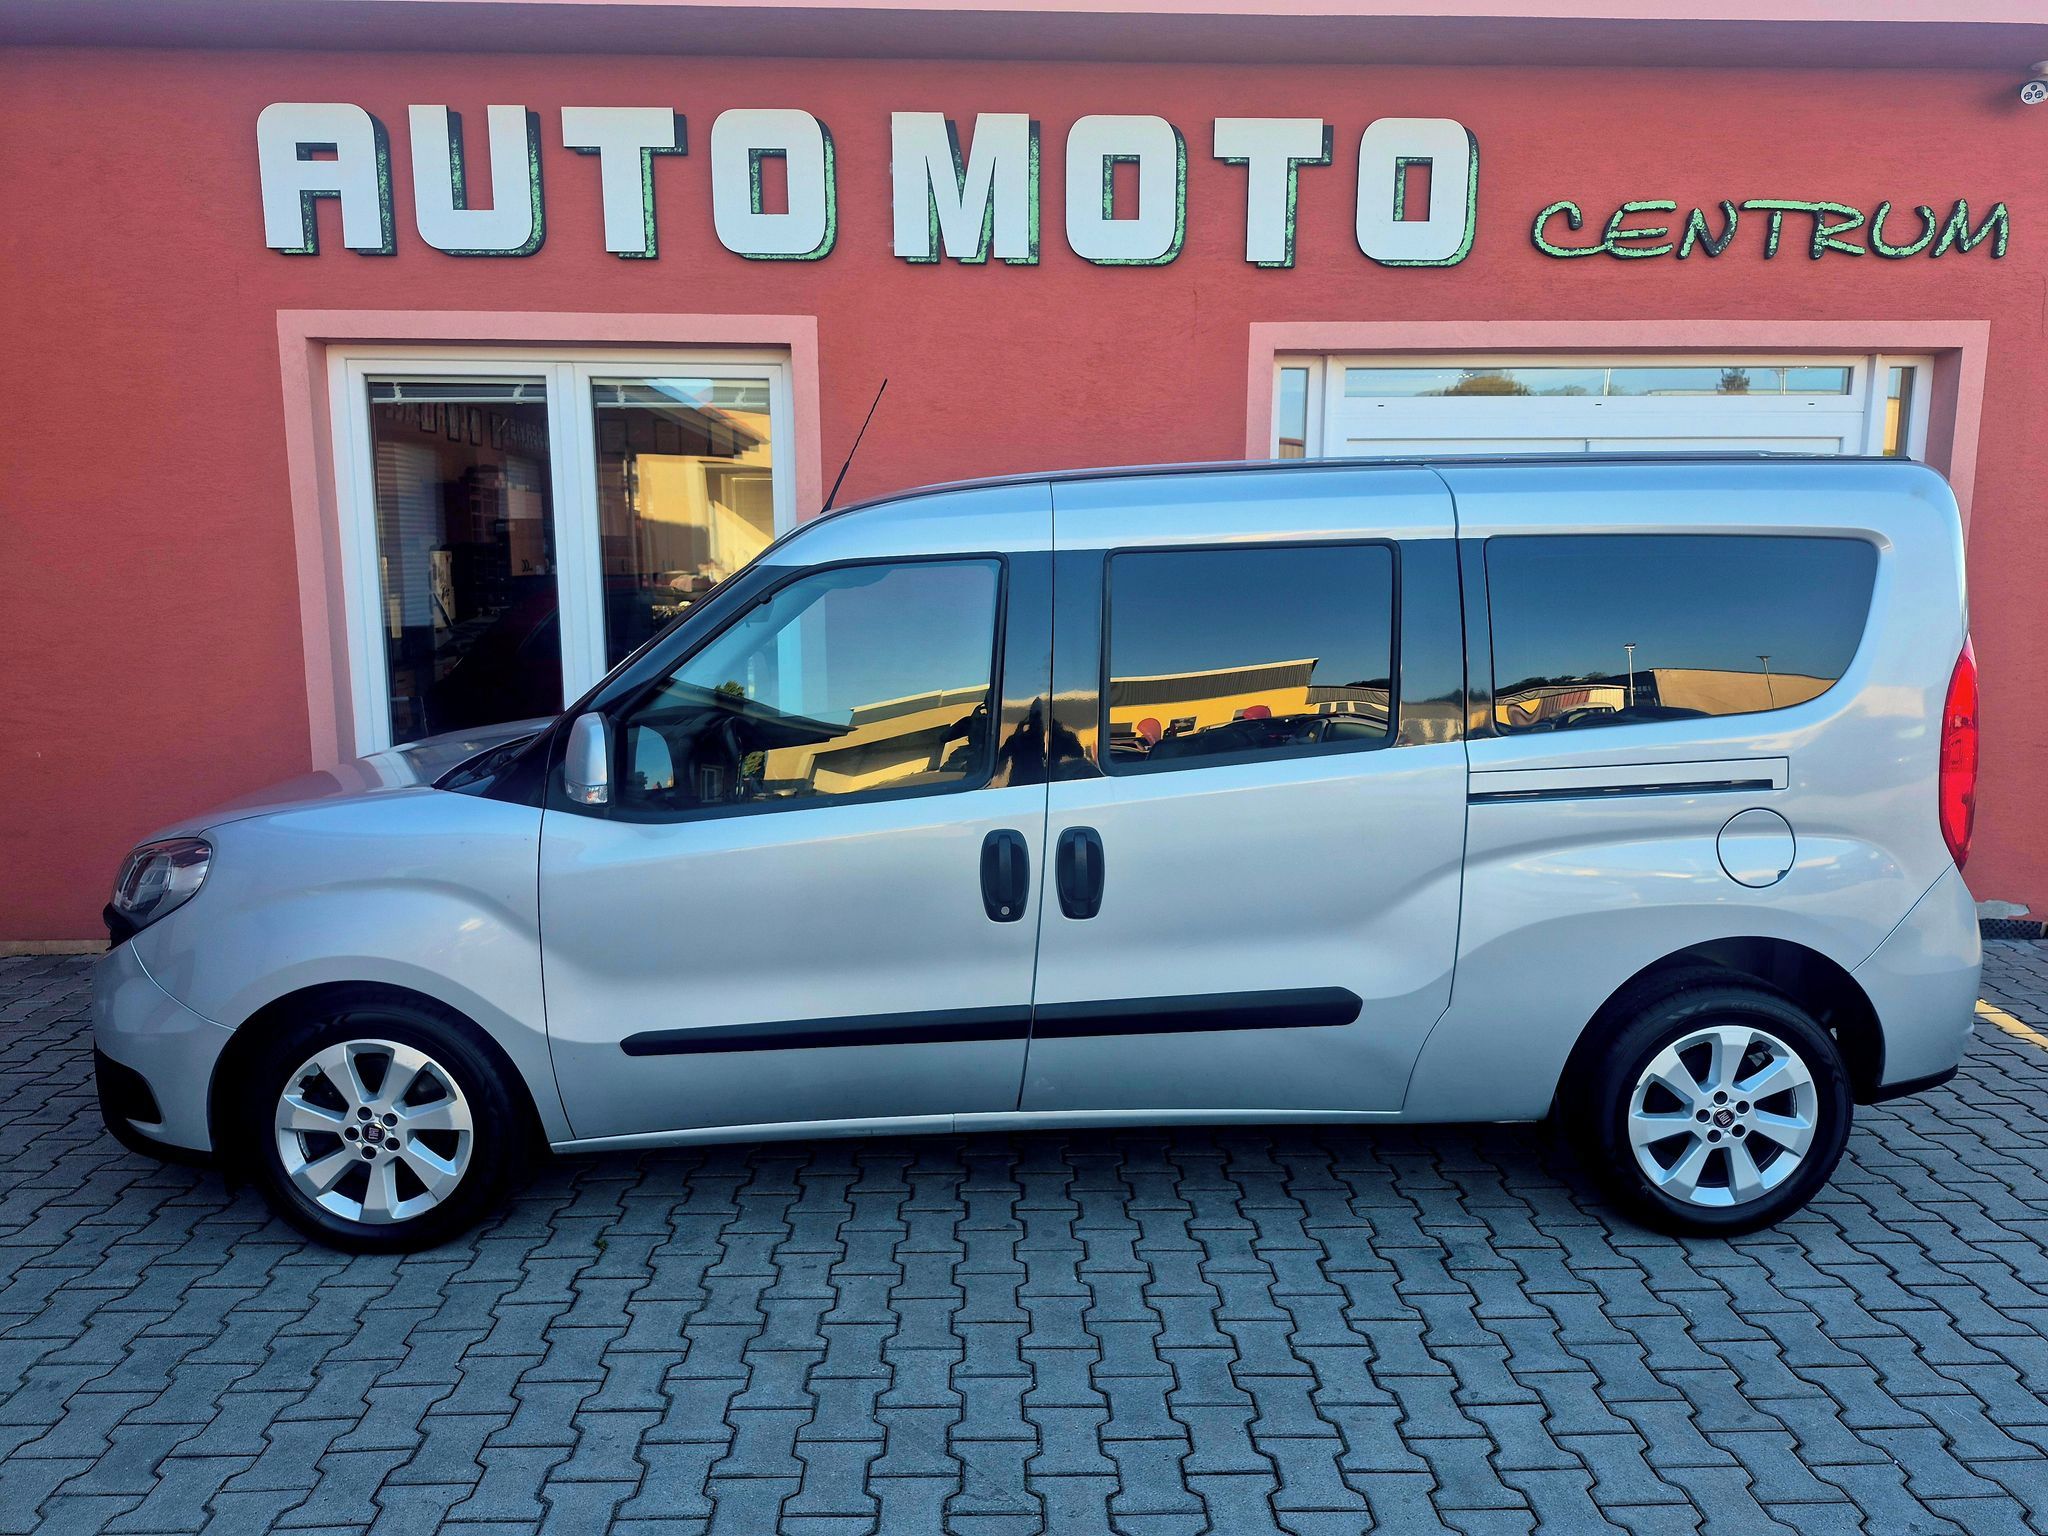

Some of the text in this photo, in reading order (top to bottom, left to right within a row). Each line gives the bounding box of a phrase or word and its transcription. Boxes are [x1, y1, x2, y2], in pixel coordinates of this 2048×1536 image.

[257, 102, 2009, 267] AUTO MOTO CENTRUM
